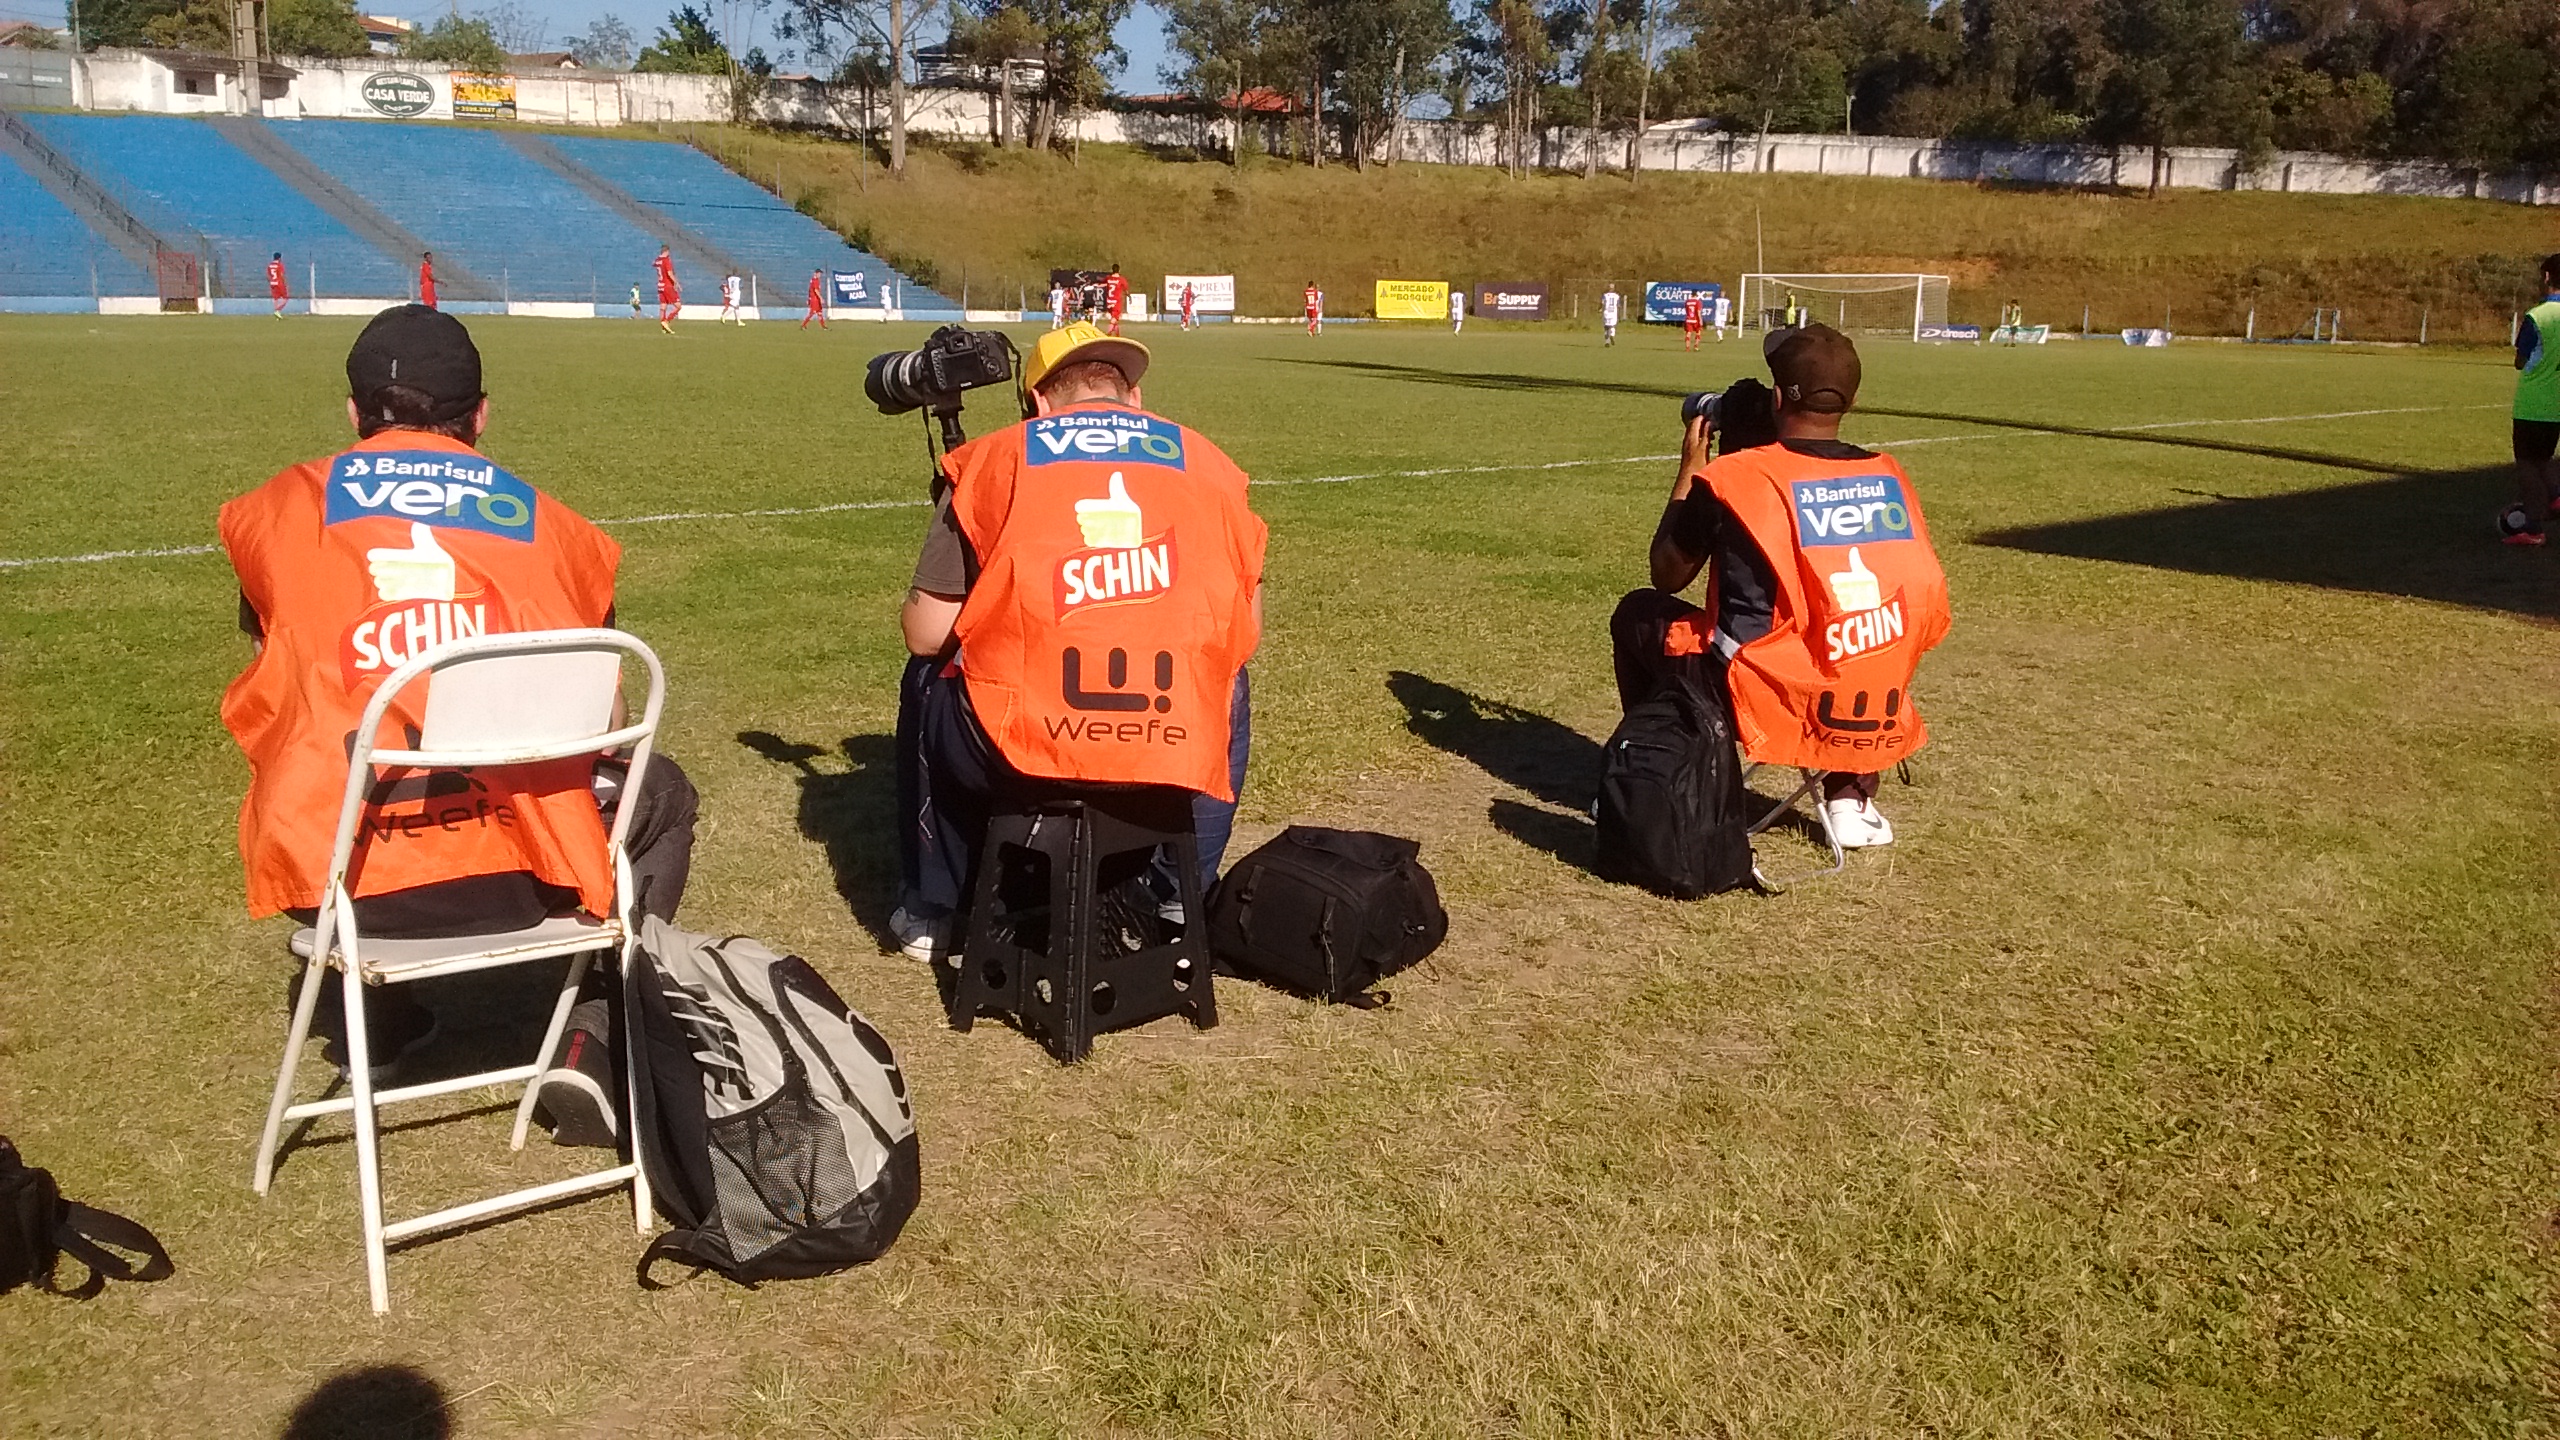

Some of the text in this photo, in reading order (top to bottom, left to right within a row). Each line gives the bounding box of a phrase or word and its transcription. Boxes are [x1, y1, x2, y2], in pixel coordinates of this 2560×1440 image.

[366, 88, 430, 103] CASA VERDE
[1108, 285, 1116, 297] 2
[1390, 284, 1435, 293] MERCADO
[1396, 293, 1434, 302] BOSQUE
[1058, 415, 1149, 430] Banrisul
[1036, 428, 1180, 459] vero
[376, 458, 494, 486] Banrisul
[342, 481, 529, 527] vero
[1816, 481, 1886, 503] Banrisul
[1802, 501, 1908, 537] vero
[1062, 544, 1171, 605] SCHIN
[352, 602, 486, 671] SCHIN
[1826, 601, 1904, 661] SCHIN
[1044, 715, 1187, 746] Weefe
[1802, 721, 1904, 752] Weefe
[353, 799, 517, 847] Weefe
